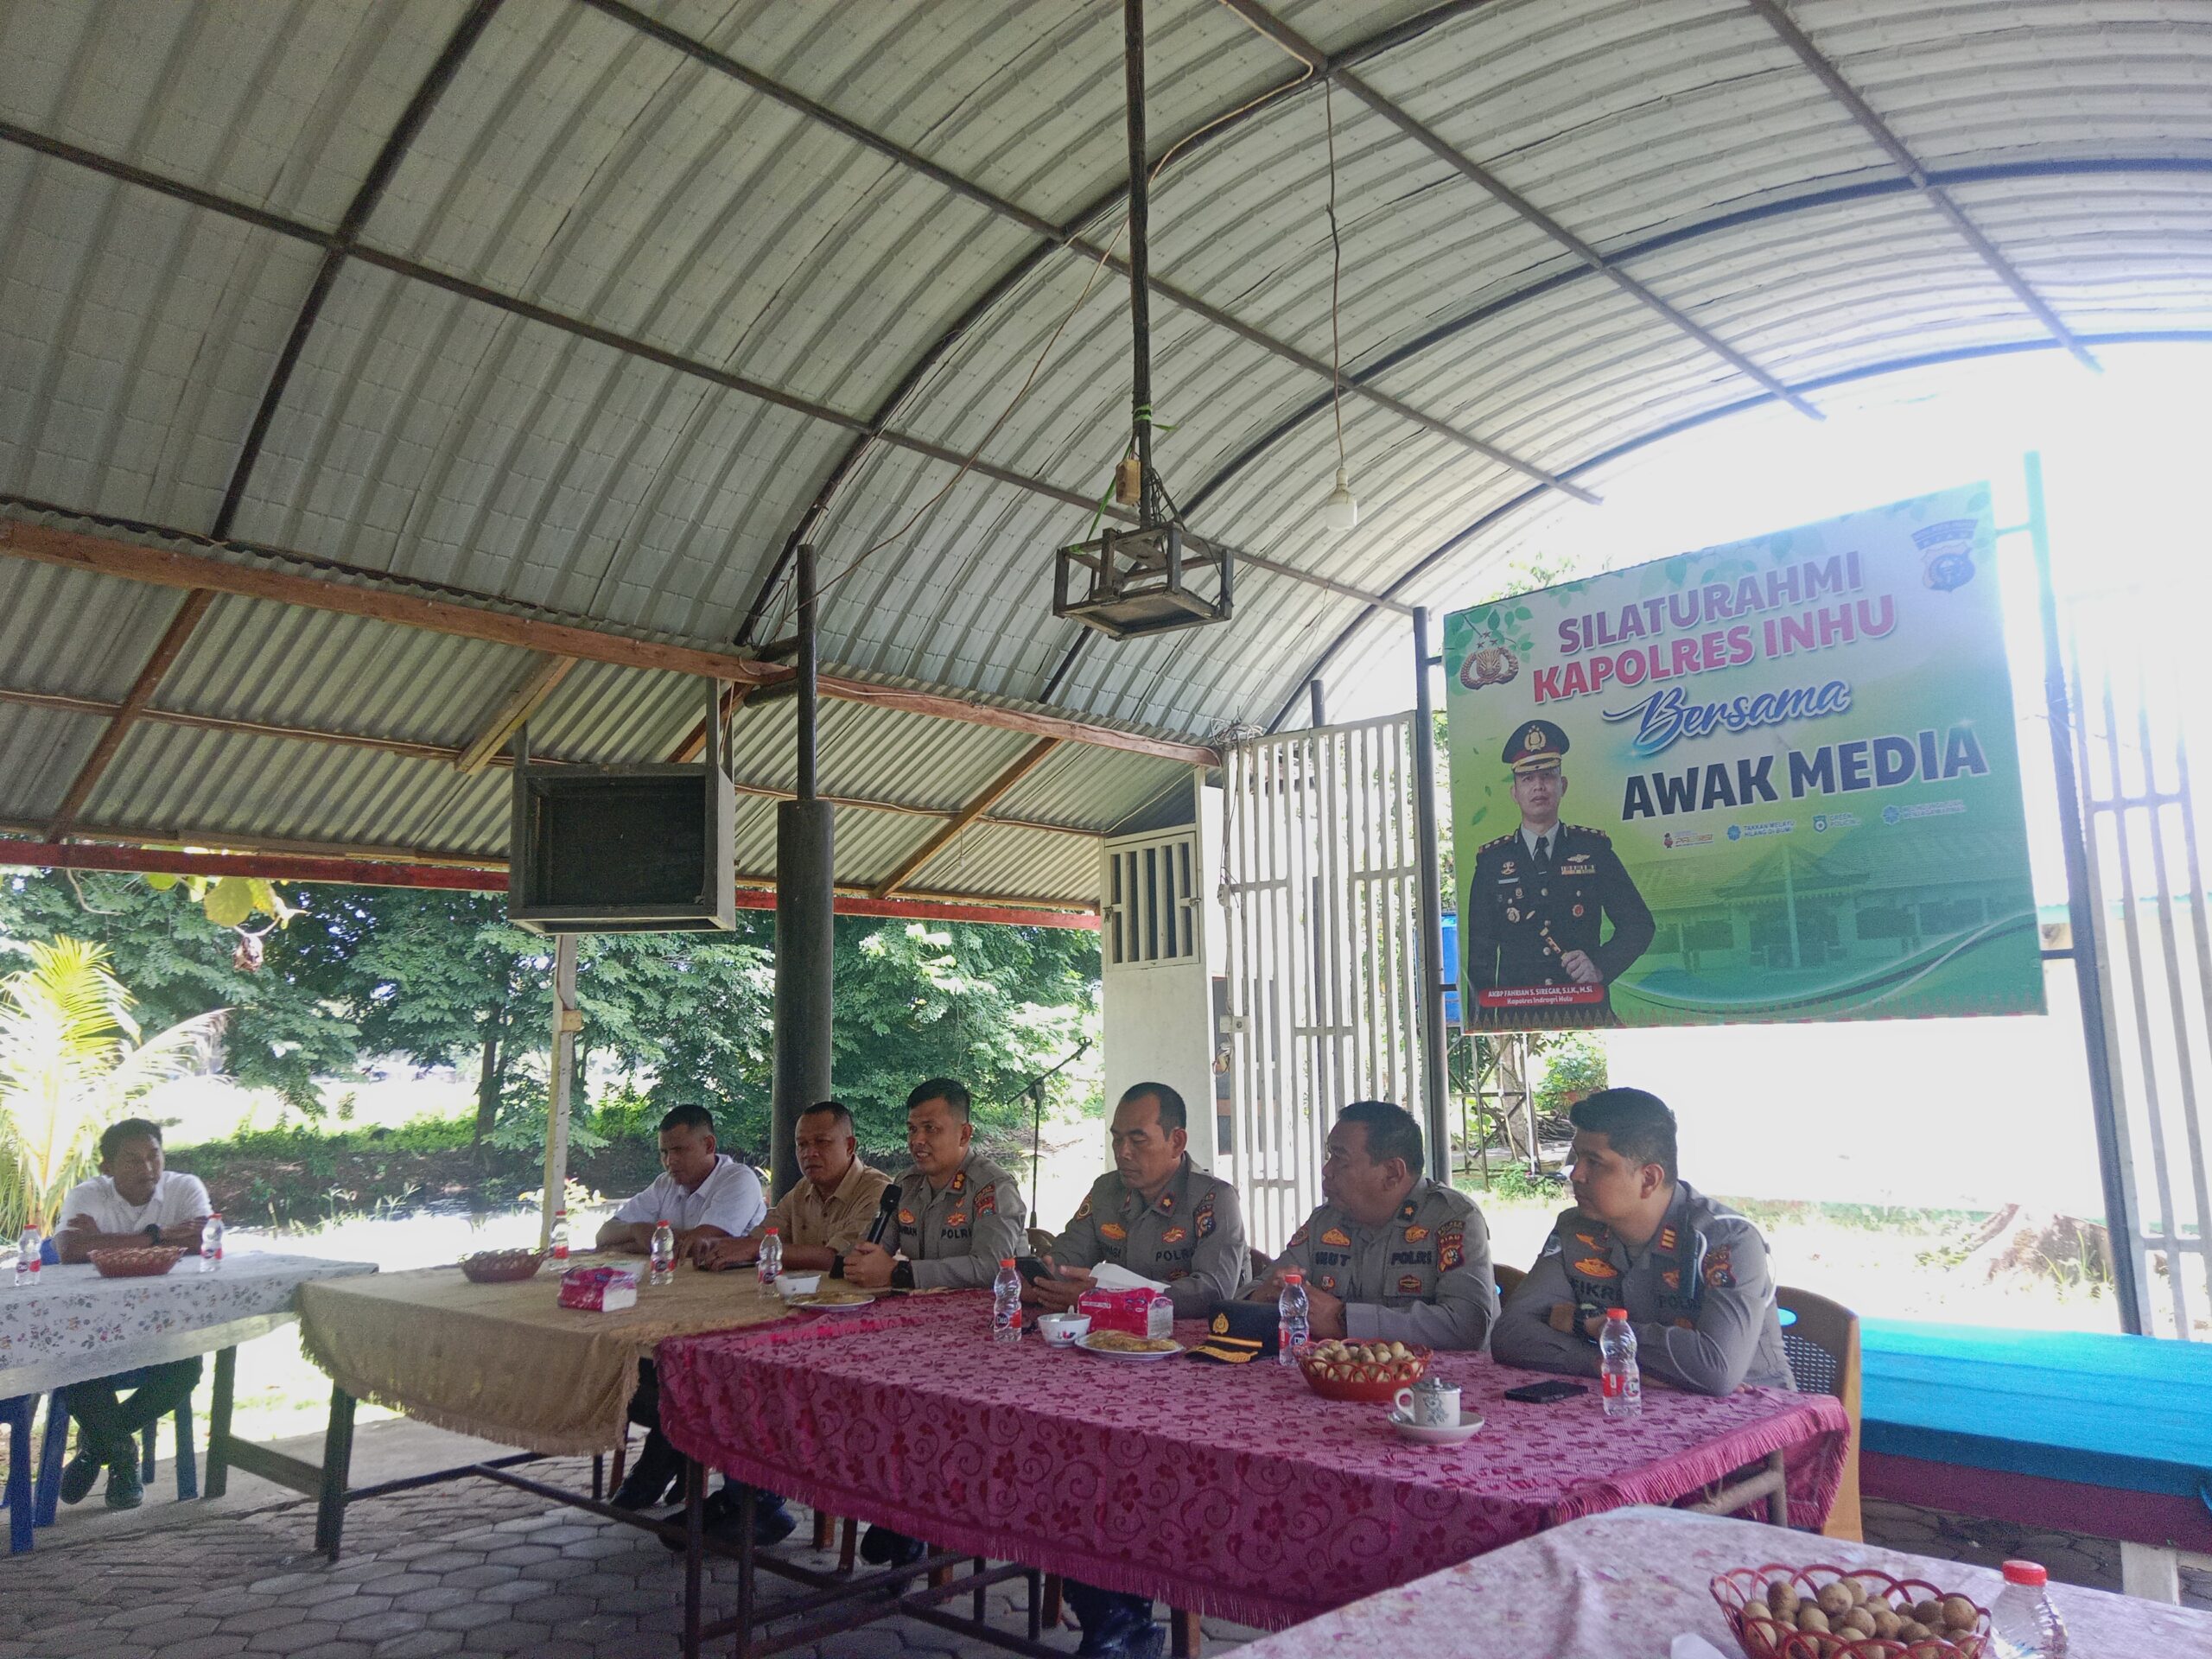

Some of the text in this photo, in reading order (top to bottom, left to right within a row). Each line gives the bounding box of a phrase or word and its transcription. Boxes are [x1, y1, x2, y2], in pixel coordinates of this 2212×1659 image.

[1533, 594, 1896, 703] KAPOLRES INHU
[1558, 551, 1863, 654] SILATURAHMI
[1602, 679, 1852, 755] Bersama
[1621, 728, 1988, 821] AWAK MEDIA
